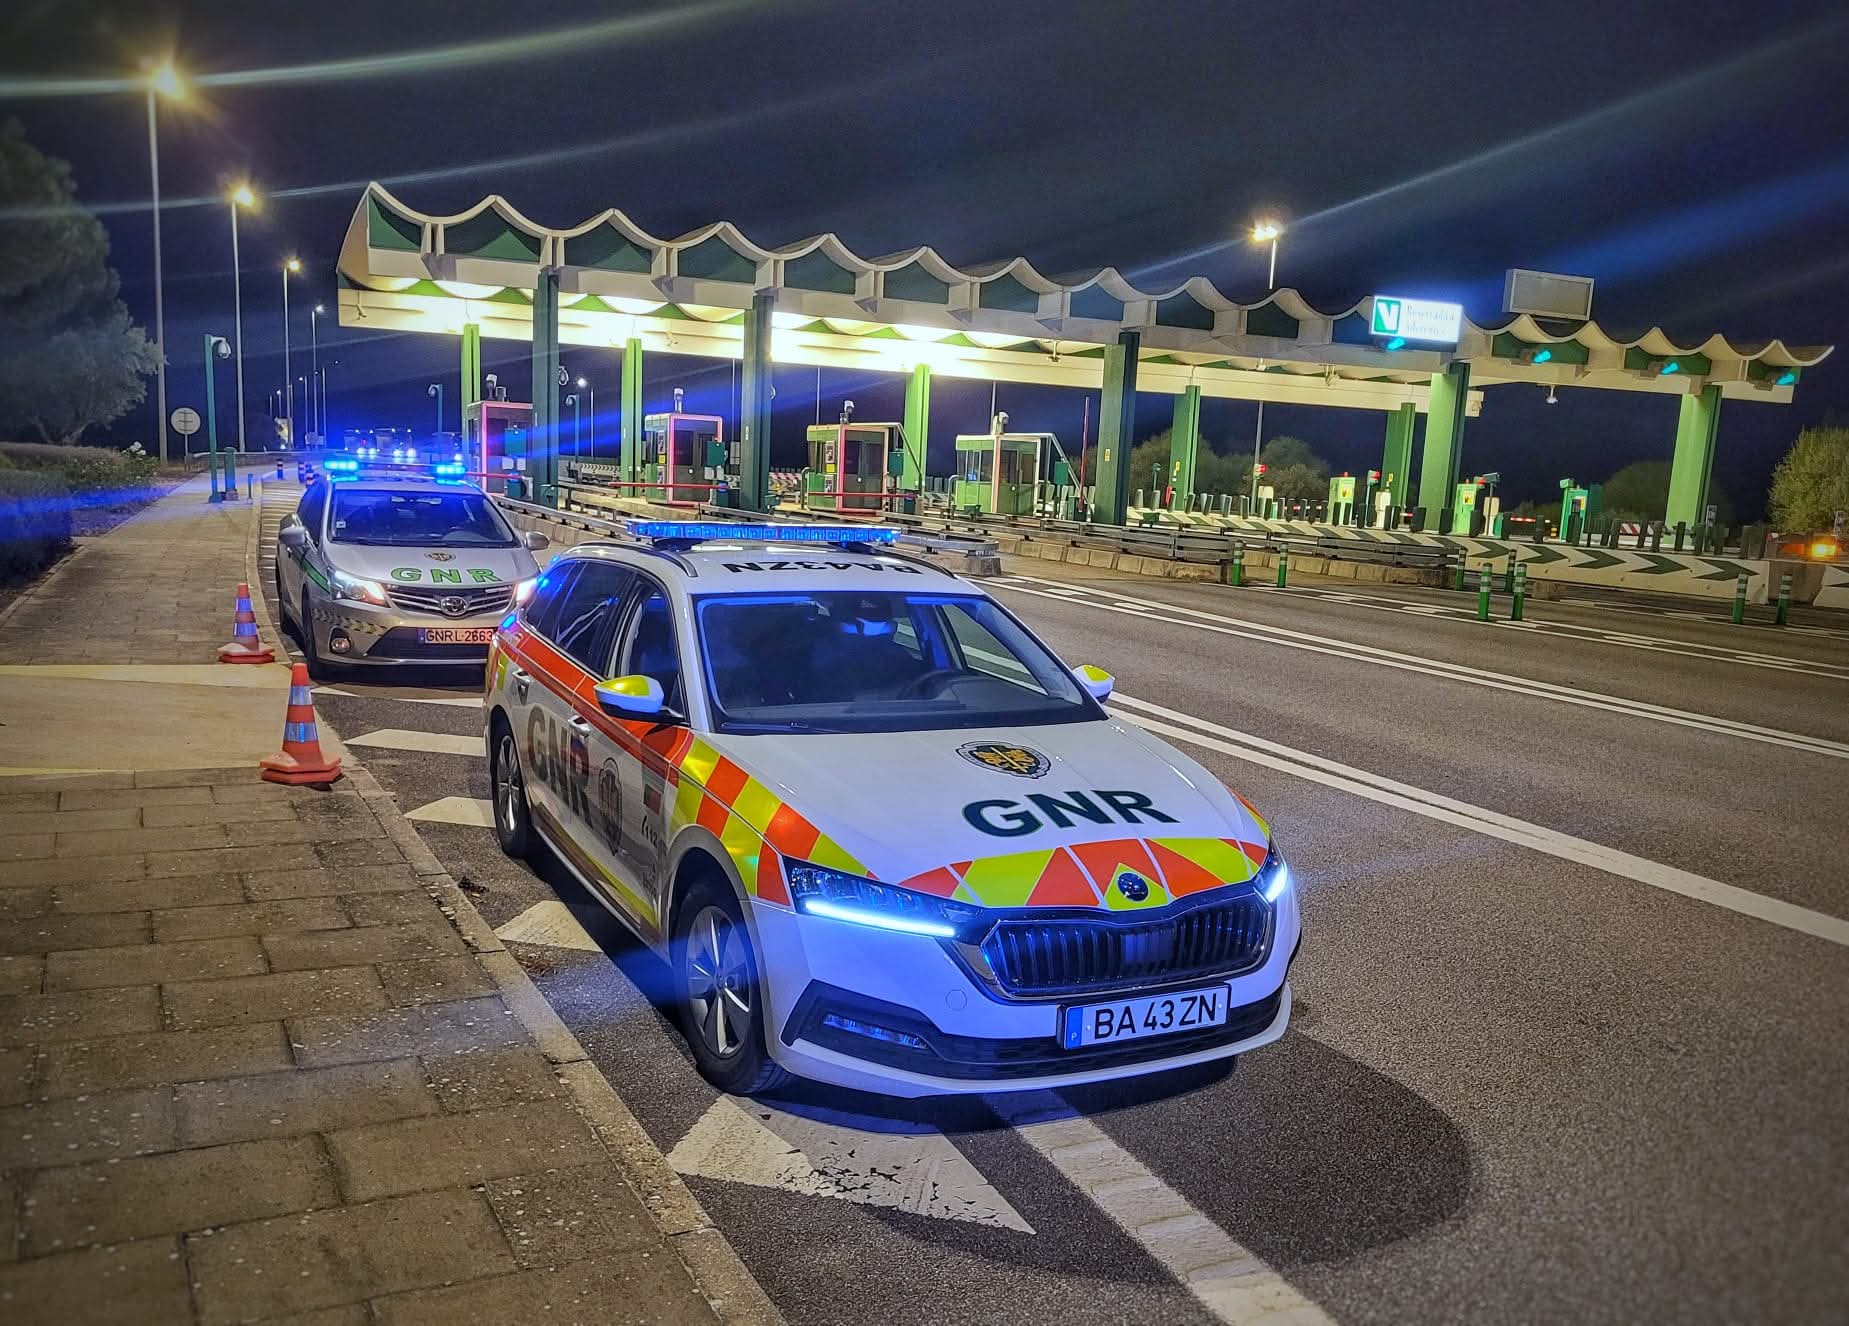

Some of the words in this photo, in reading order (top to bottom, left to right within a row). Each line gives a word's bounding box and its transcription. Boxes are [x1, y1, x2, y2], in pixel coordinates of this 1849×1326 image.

[391, 567, 502, 583] GNR
[527, 704, 594, 830] GNR
[961, 789, 1181, 838] GNR
